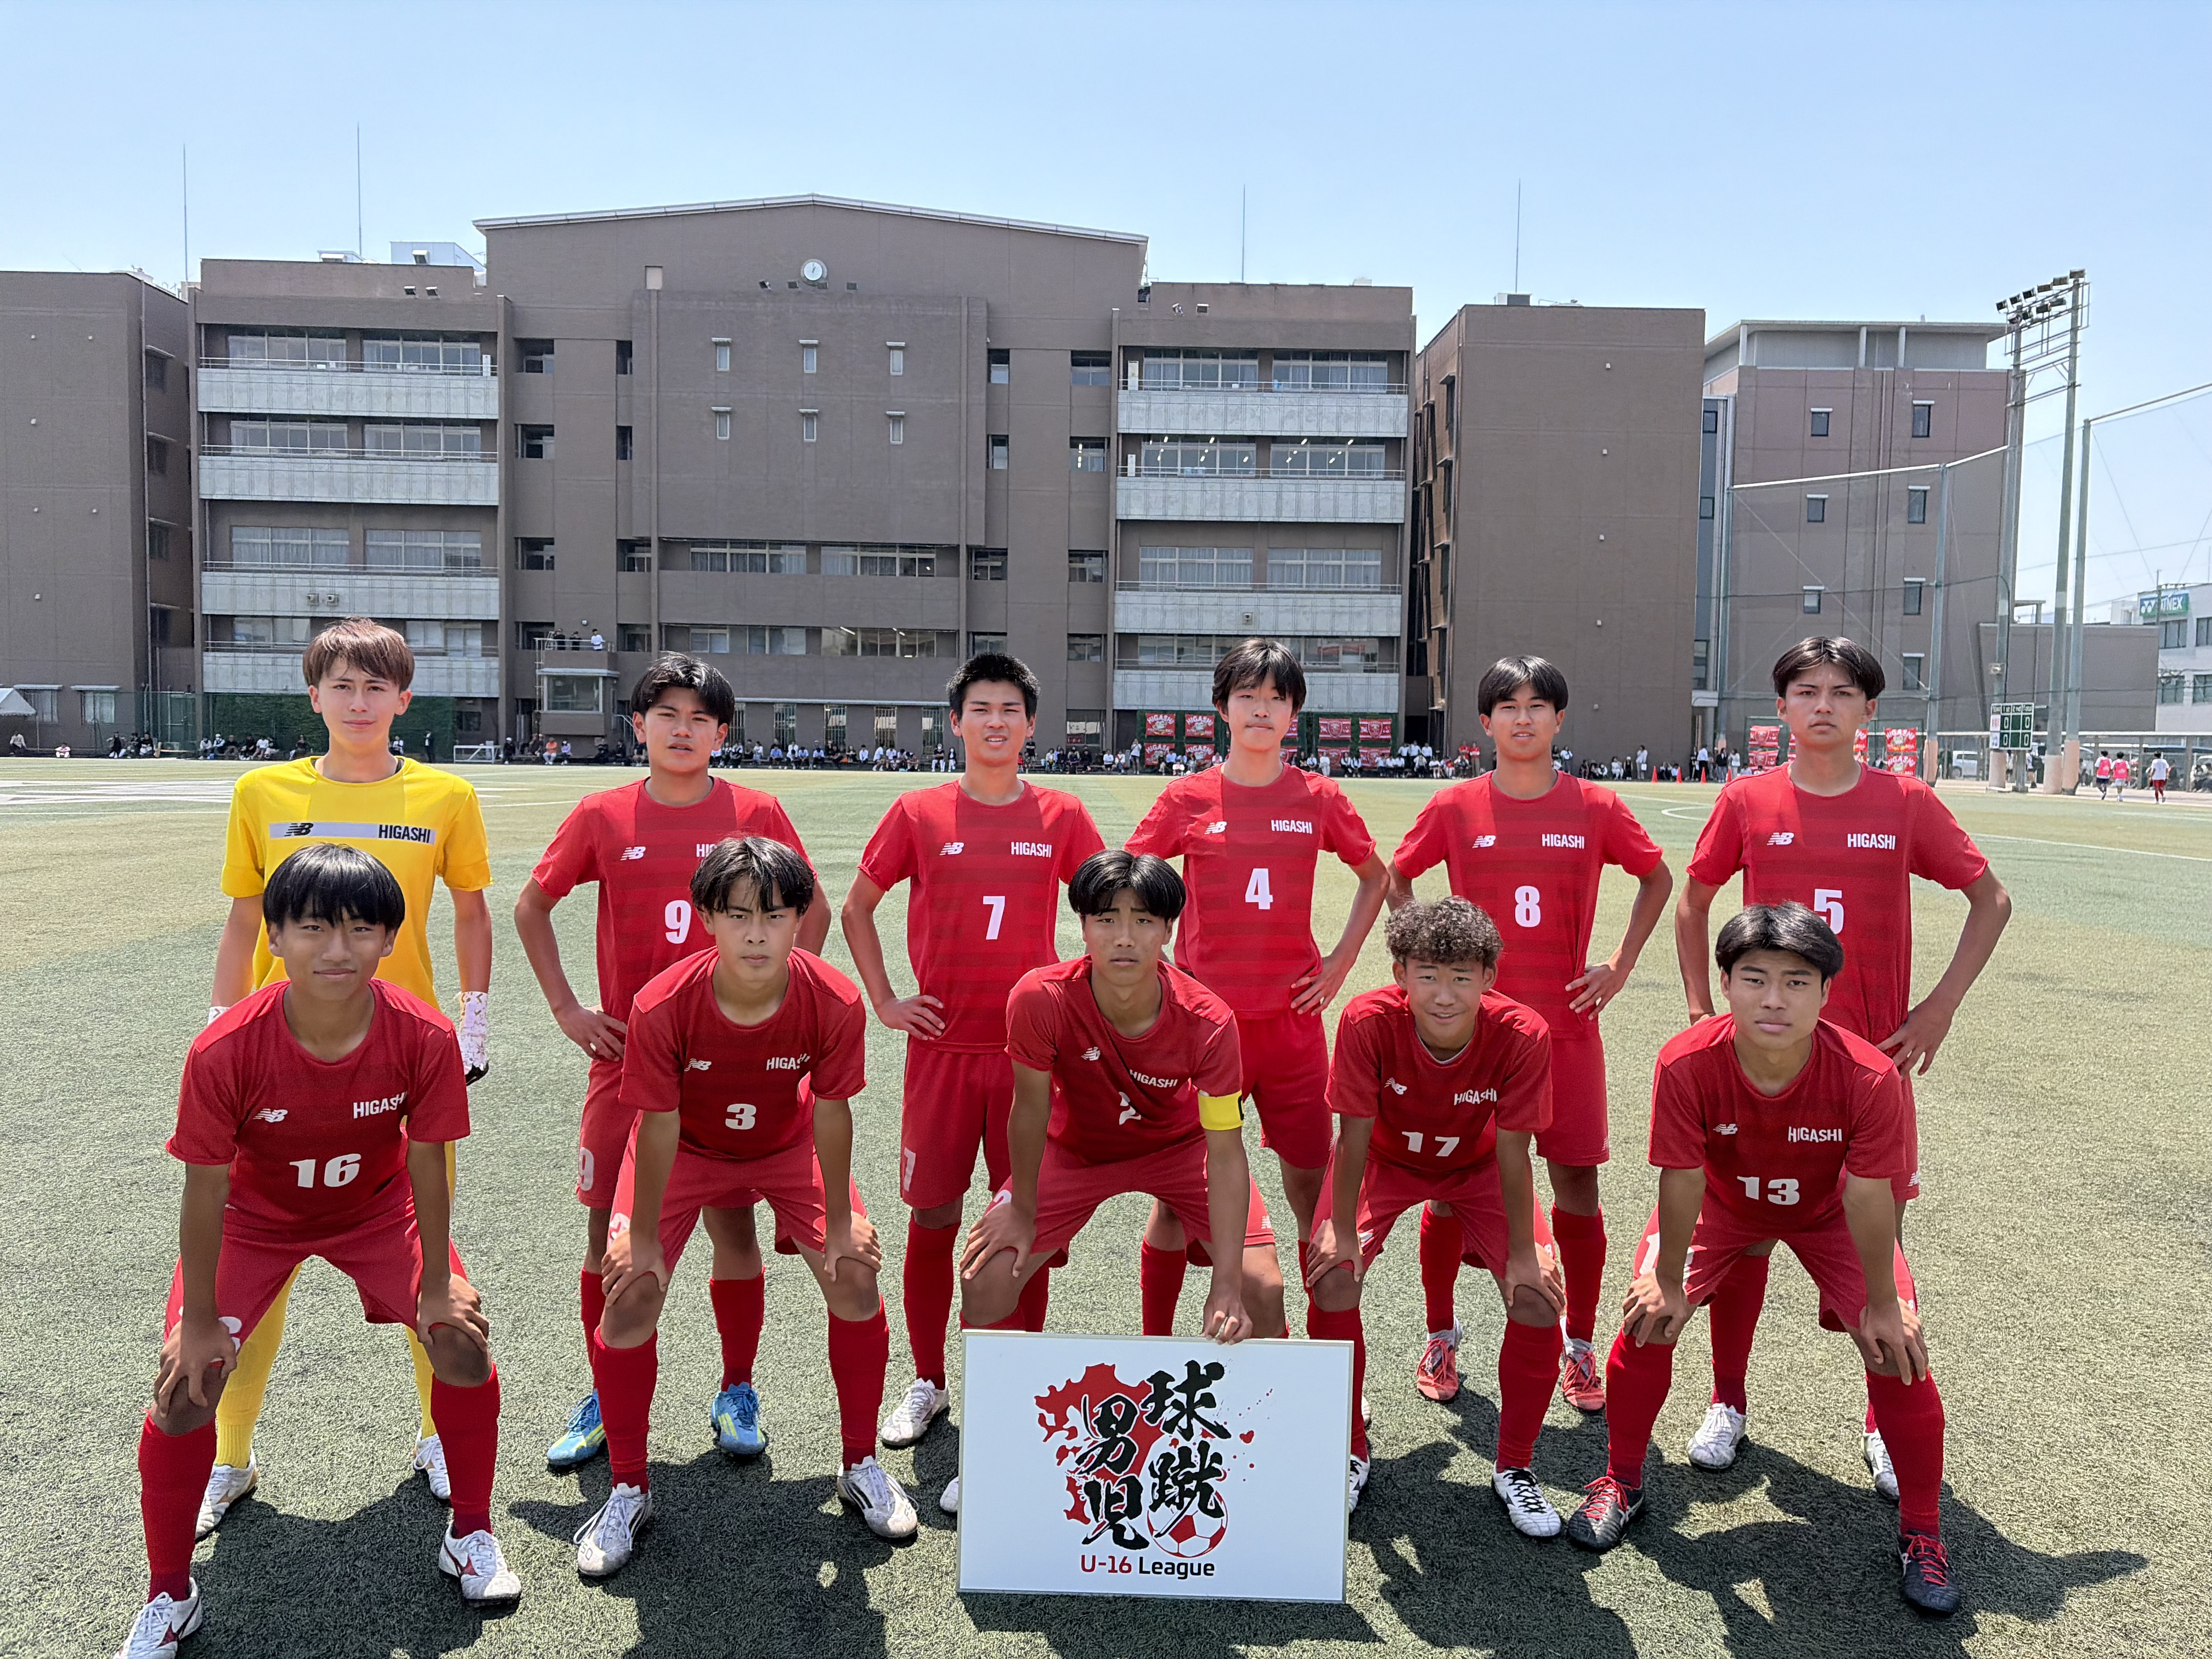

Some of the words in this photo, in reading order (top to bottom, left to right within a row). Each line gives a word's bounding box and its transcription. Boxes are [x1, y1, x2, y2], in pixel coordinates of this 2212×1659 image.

[1147, 714, 1175, 724] HIGASHI
[1186, 716, 1214, 726] HIGASHI
[2004, 716, 2009, 729] 0
[2025, 716, 2030, 729] 0
[2003, 734, 2008, 746] 0
[2024, 733, 2029, 746] 0
[379, 824, 431, 843] HIGASHI
[1271, 820, 1313, 834] HIGASHI
[1011, 842, 1052, 858] HIGASHI
[1542, 833, 1584, 849] HIGASHI
[1847, 833, 1896, 850] HIGASHI
[1245, 868, 1273, 910] 4
[983, 895, 1006, 940] 7
[1515, 885, 1541, 928] 8
[1814, 888, 1844, 935] 5
[664, 900, 691, 944] 9
[1130, 1069, 1178, 1088] HIGASHI
[1454, 1088, 1497, 1106] HIGASHI
[725, 1103, 757, 1130] 3
[1401, 1131, 1460, 1157] 17
[1787, 1126, 1842, 1143] HIGASHI
[289, 1153, 362, 1188] 16
[578, 1147, 594, 1192] 9
[1736, 1176, 1800, 1205] 13
[1075, 1393, 1149, 1550] 男児
[1081, 1554, 1132, 1574] U-16
[1139, 1556, 1215, 1580] League
